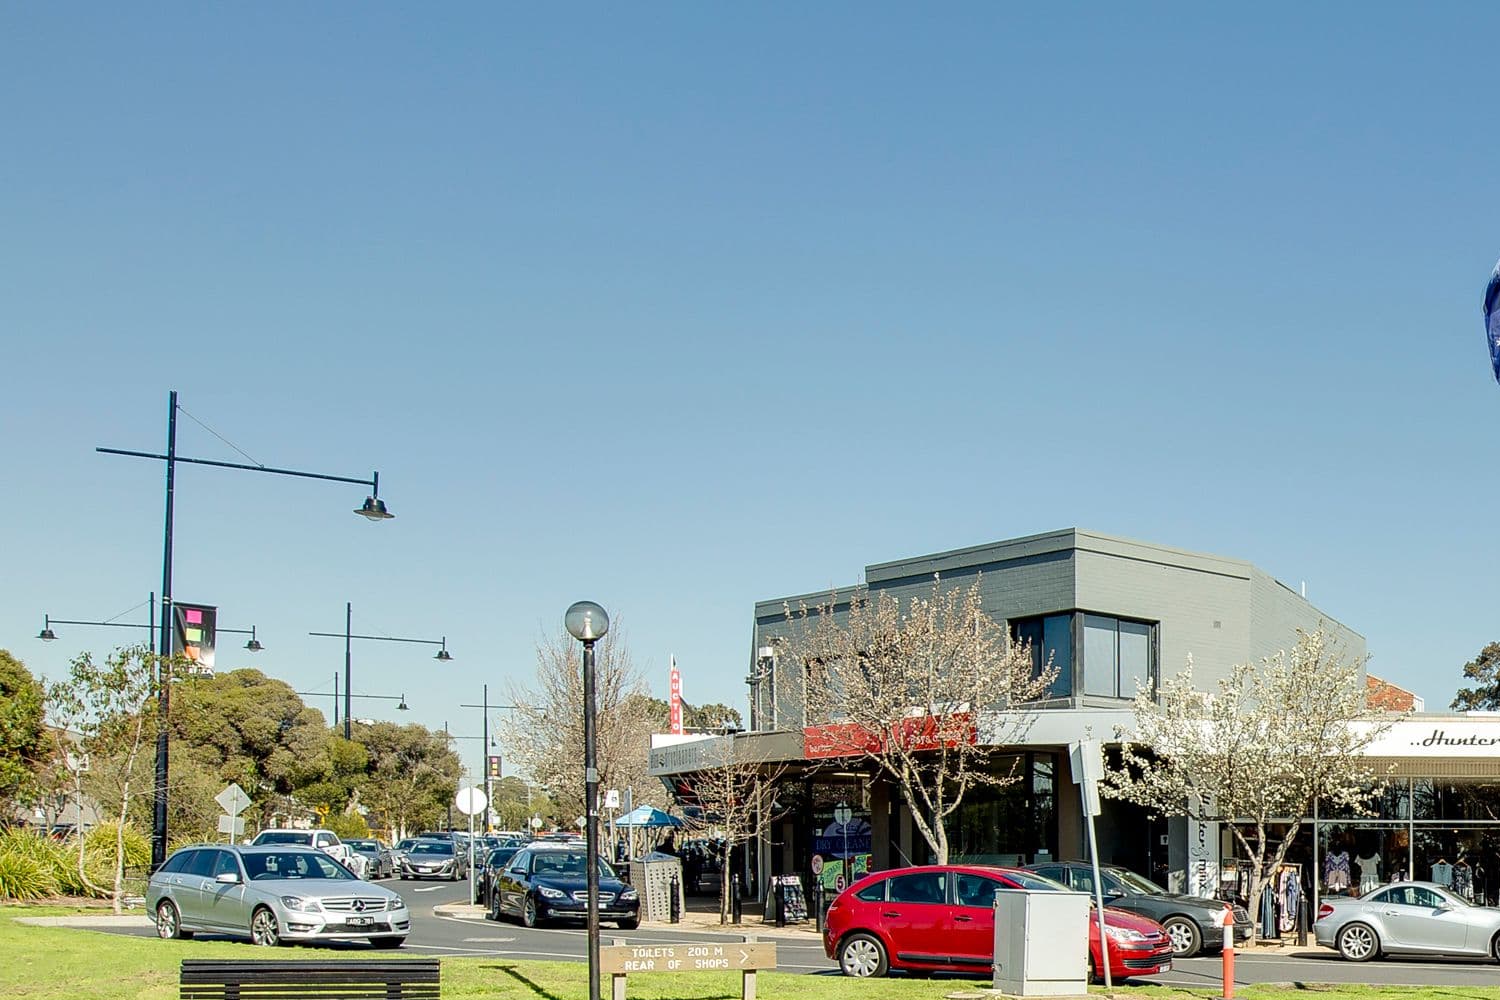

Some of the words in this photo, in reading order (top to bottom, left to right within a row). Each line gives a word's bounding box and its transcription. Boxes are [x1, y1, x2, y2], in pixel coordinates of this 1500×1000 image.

[688, 947, 709, 957] 200
[714, 946, 723, 956] M
[625, 960, 655, 971] REAR
[667, 960, 682, 970] OF
[695, 959, 729, 969] SHOPS
